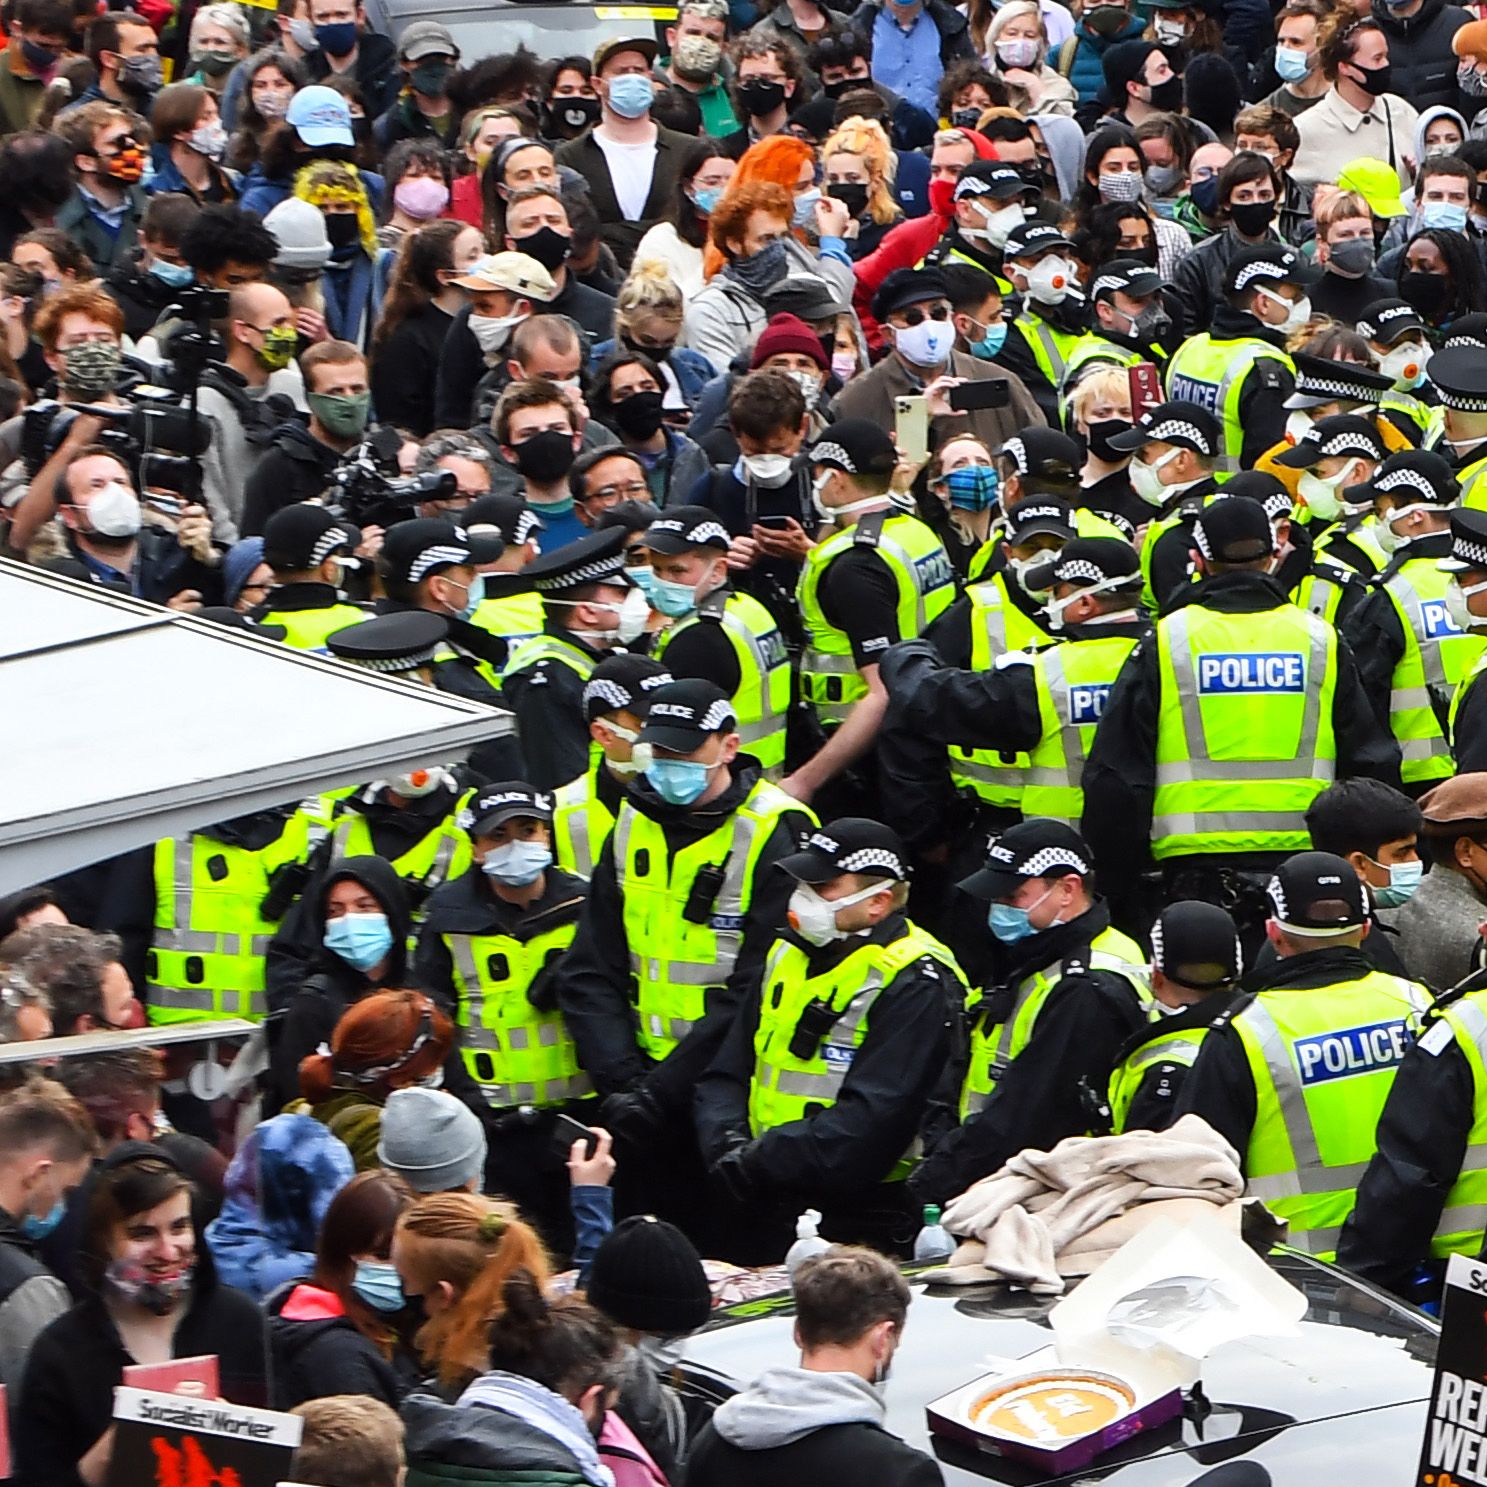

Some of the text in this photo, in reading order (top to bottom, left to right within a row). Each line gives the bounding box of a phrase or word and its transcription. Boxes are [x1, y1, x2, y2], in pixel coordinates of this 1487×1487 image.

[1018, 507, 1062, 521] POLICE
[1201, 655, 1302, 690] POLICE
[1299, 1025, 1406, 1078] POLICE
[140, 1398, 275, 1439] Socialist Worker
